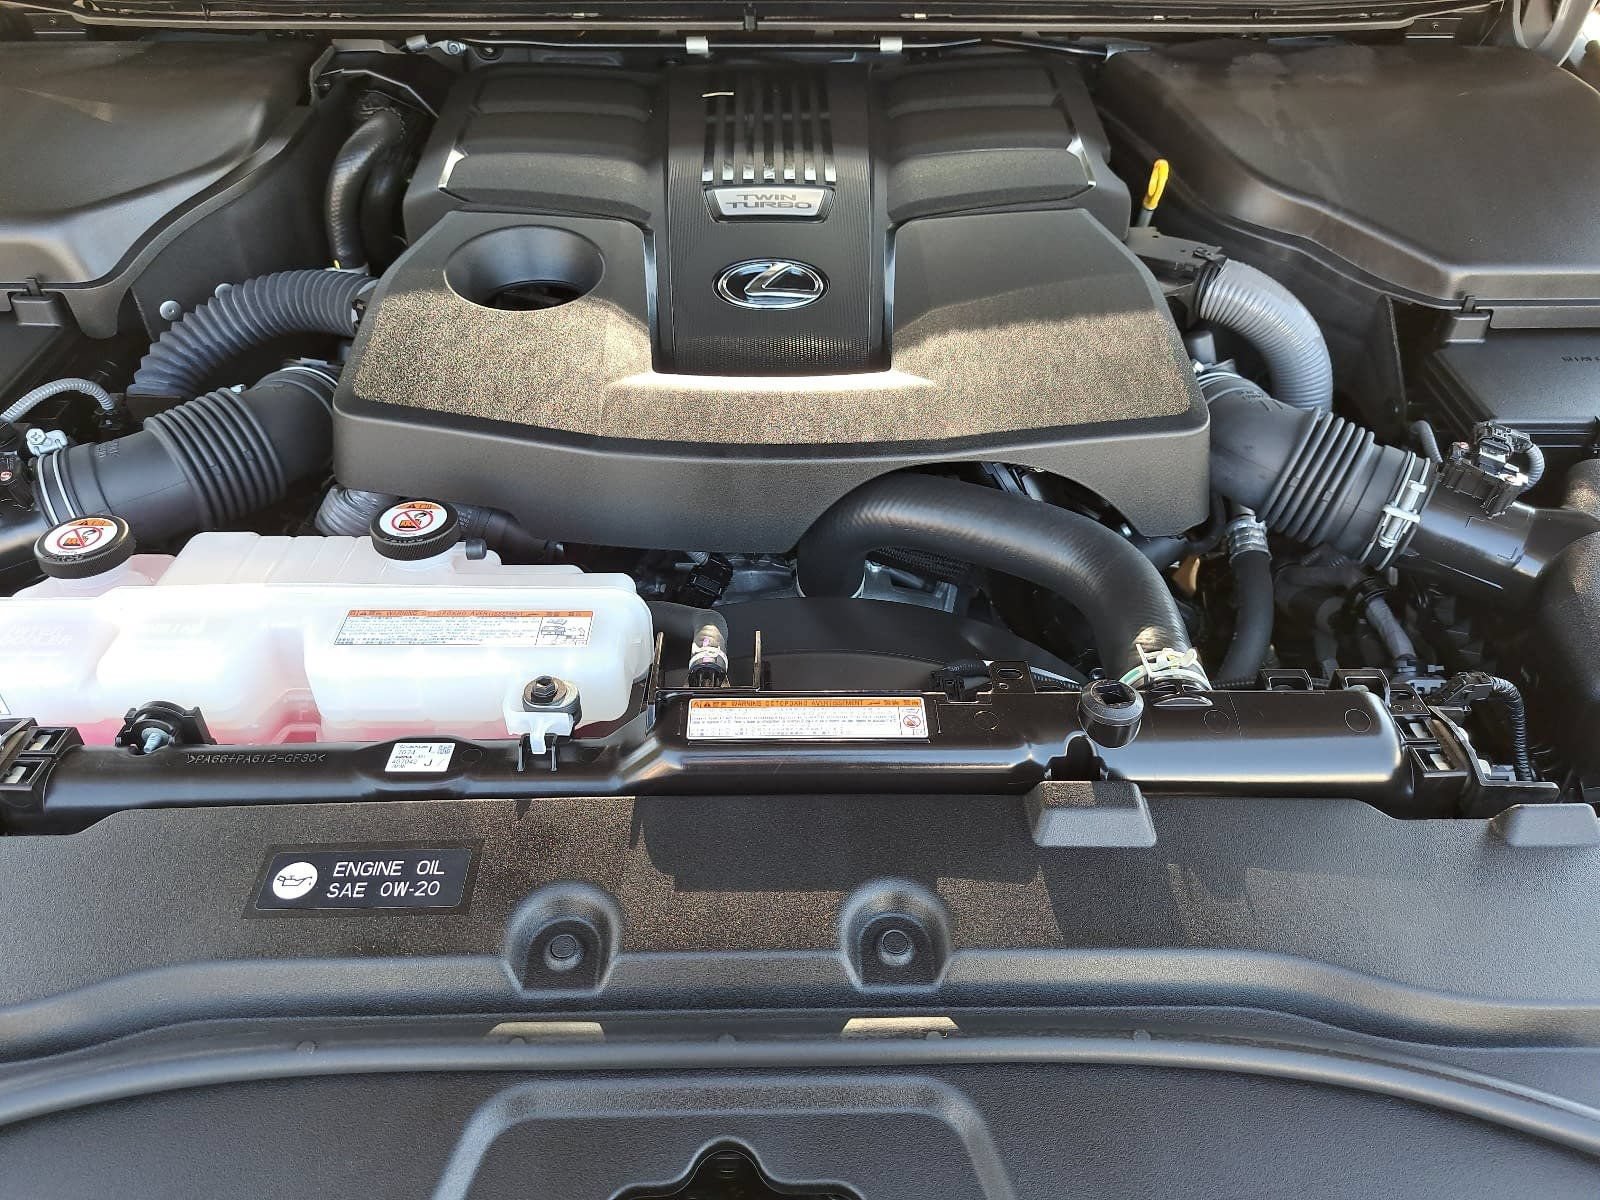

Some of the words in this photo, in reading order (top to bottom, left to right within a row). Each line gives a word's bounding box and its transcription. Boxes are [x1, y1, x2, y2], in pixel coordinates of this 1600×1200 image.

[725, 201, 812, 209] TURBO
[333, 861, 404, 877] ENGINE
[416, 860, 445, 875] OIL
[326, 882, 368, 898] SAE
[380, 881, 441, 897] 0W-20
